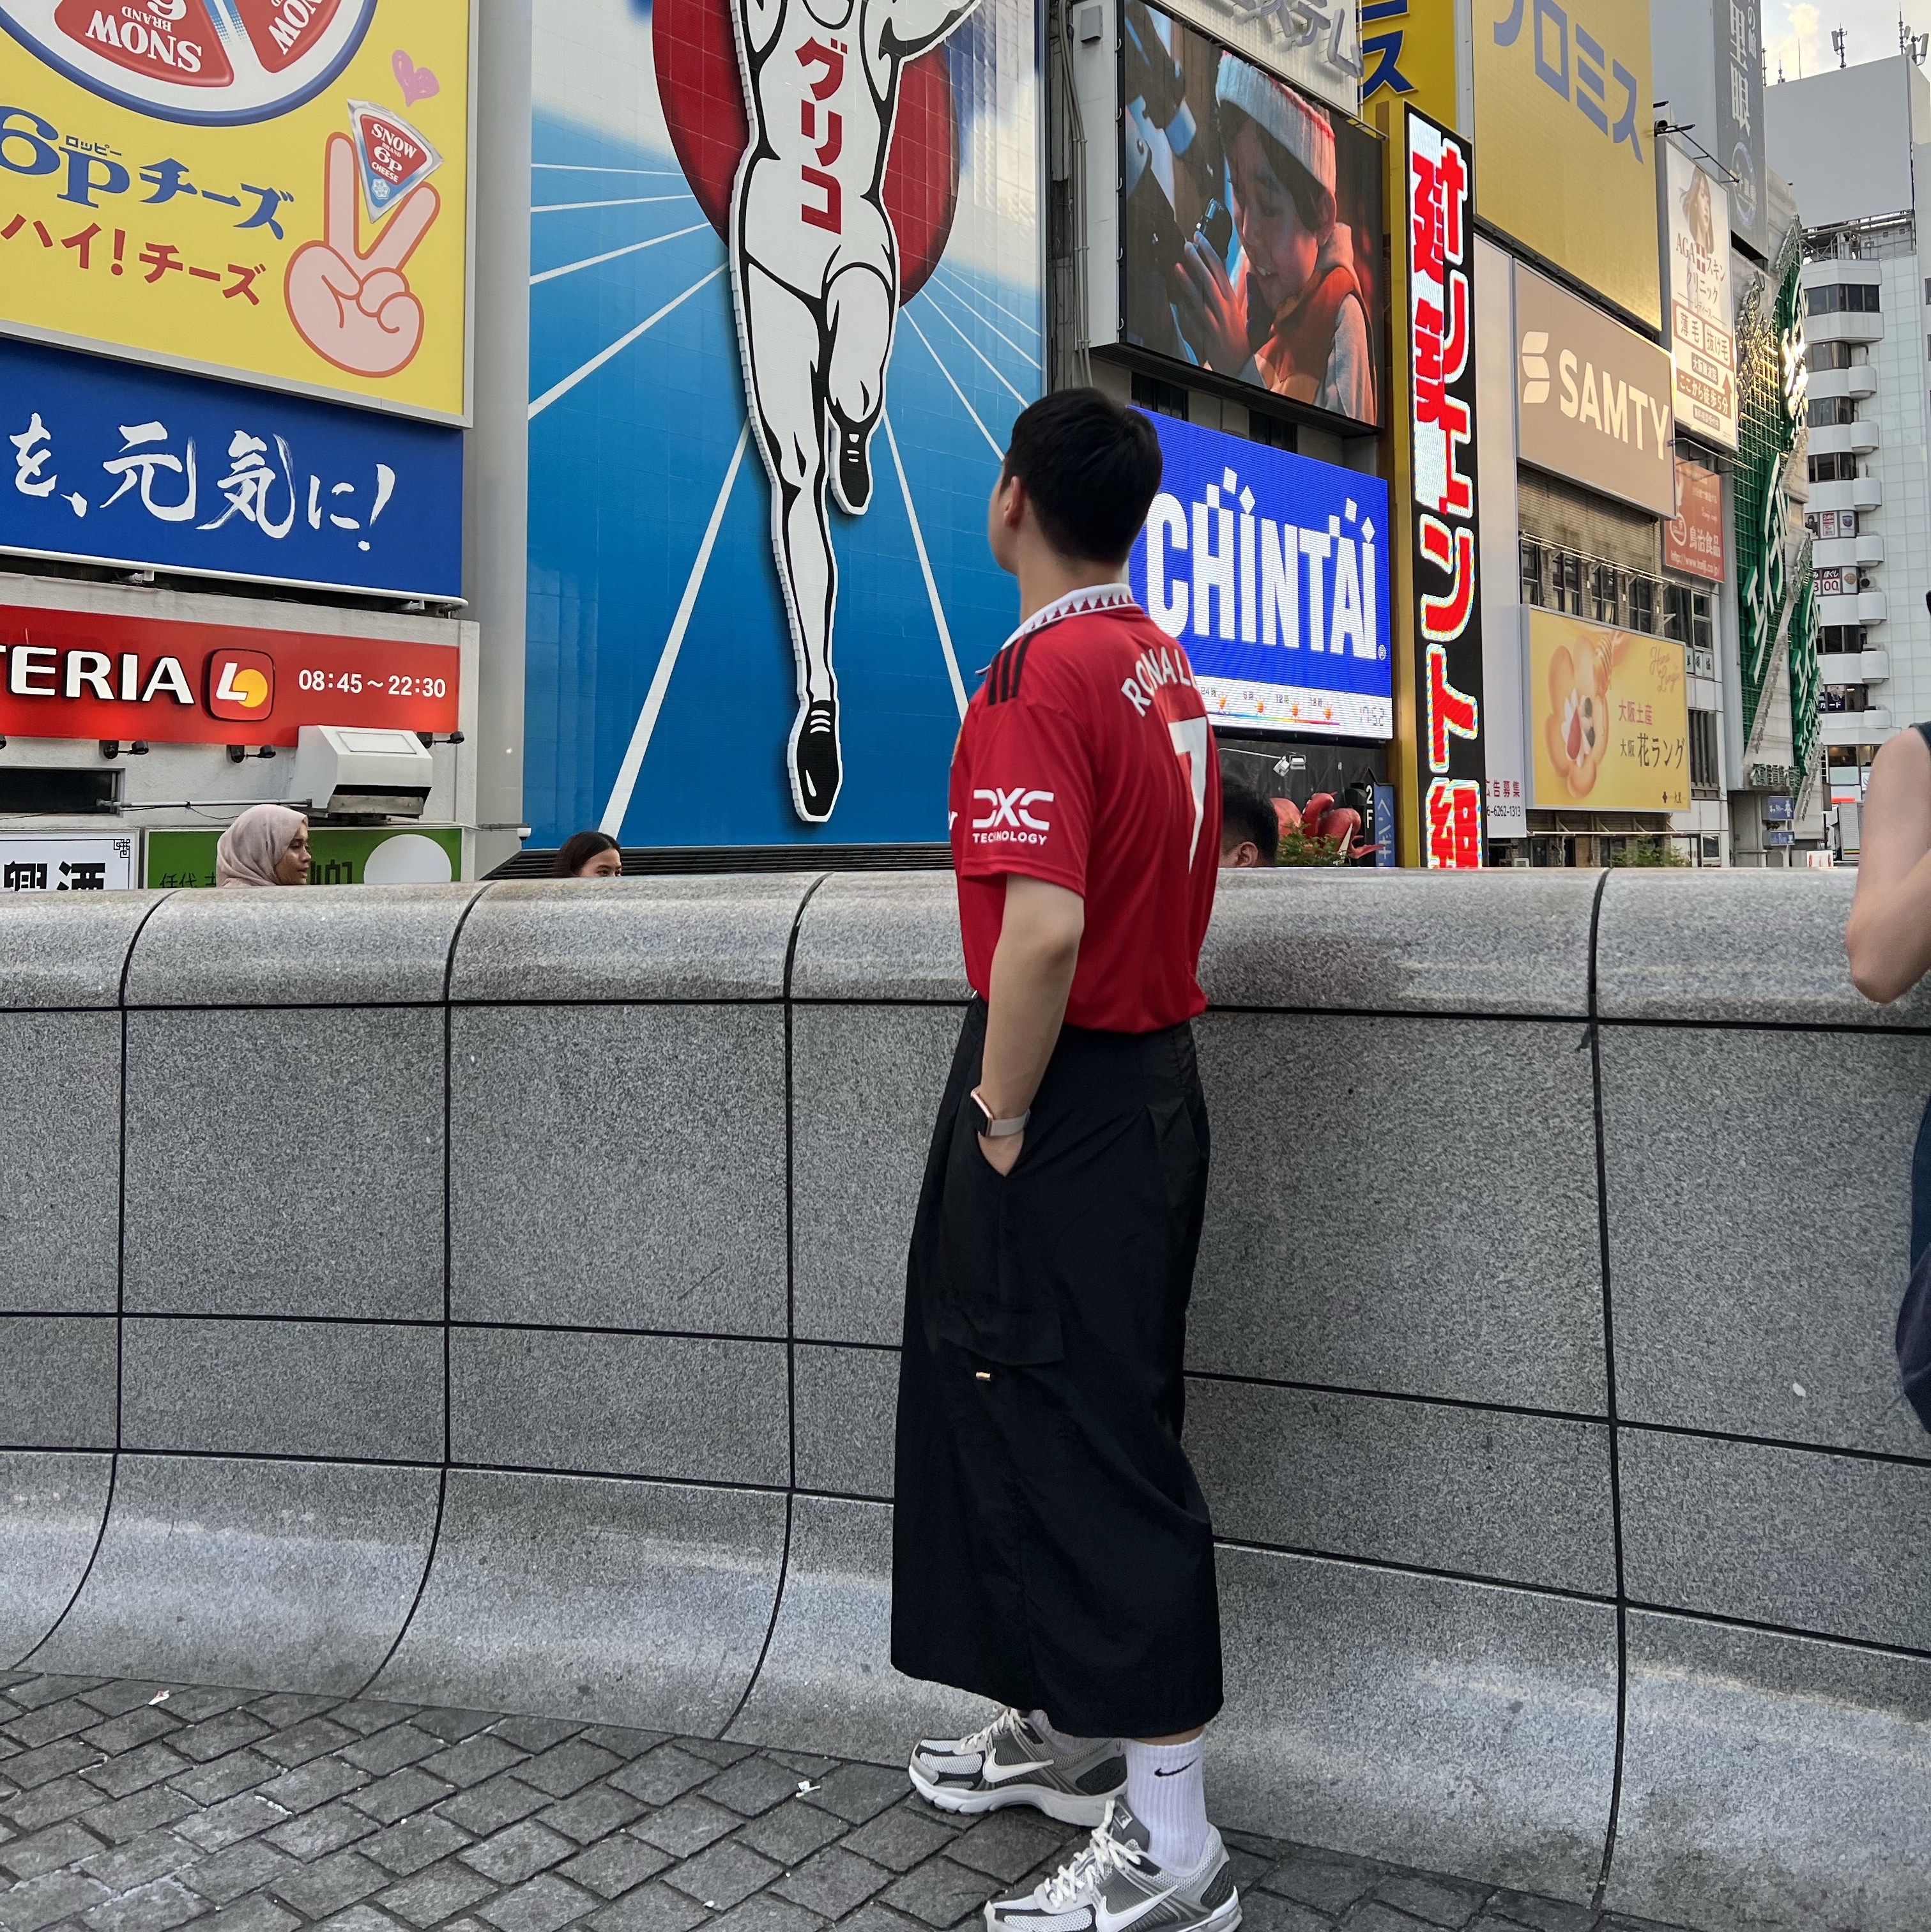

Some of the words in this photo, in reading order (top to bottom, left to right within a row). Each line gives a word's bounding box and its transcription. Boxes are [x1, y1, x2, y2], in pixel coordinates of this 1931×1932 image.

[86, 10, 202, 73] SNOW
[121, 6, 172, 33] BRAND
[268, 0, 323, 56] OW
[1747, 0, 1757, 60] の館
[371, 123, 418, 159] SNOW
[381, 142, 402, 158] BRAND
[795, 36, 848, 235] グリコ
[371, 161, 399, 183] CHEESE
[1675, 233, 1696, 264] AGA
[1707, 257, 1725, 282] スキン
[1687, 268, 1718, 305] クリニック
[1559, 349, 1669, 460] SAMTY
[1147, 464, 1377, 661] CHINTAI
[0, 644, 195, 705] ERIA
[1121, 646, 1198, 717] RONAL
[972, 787, 1055, 831] DXC
[1168, 716, 1209, 874] 7
[972, 831, 1048, 845] TECHNOLOGY
